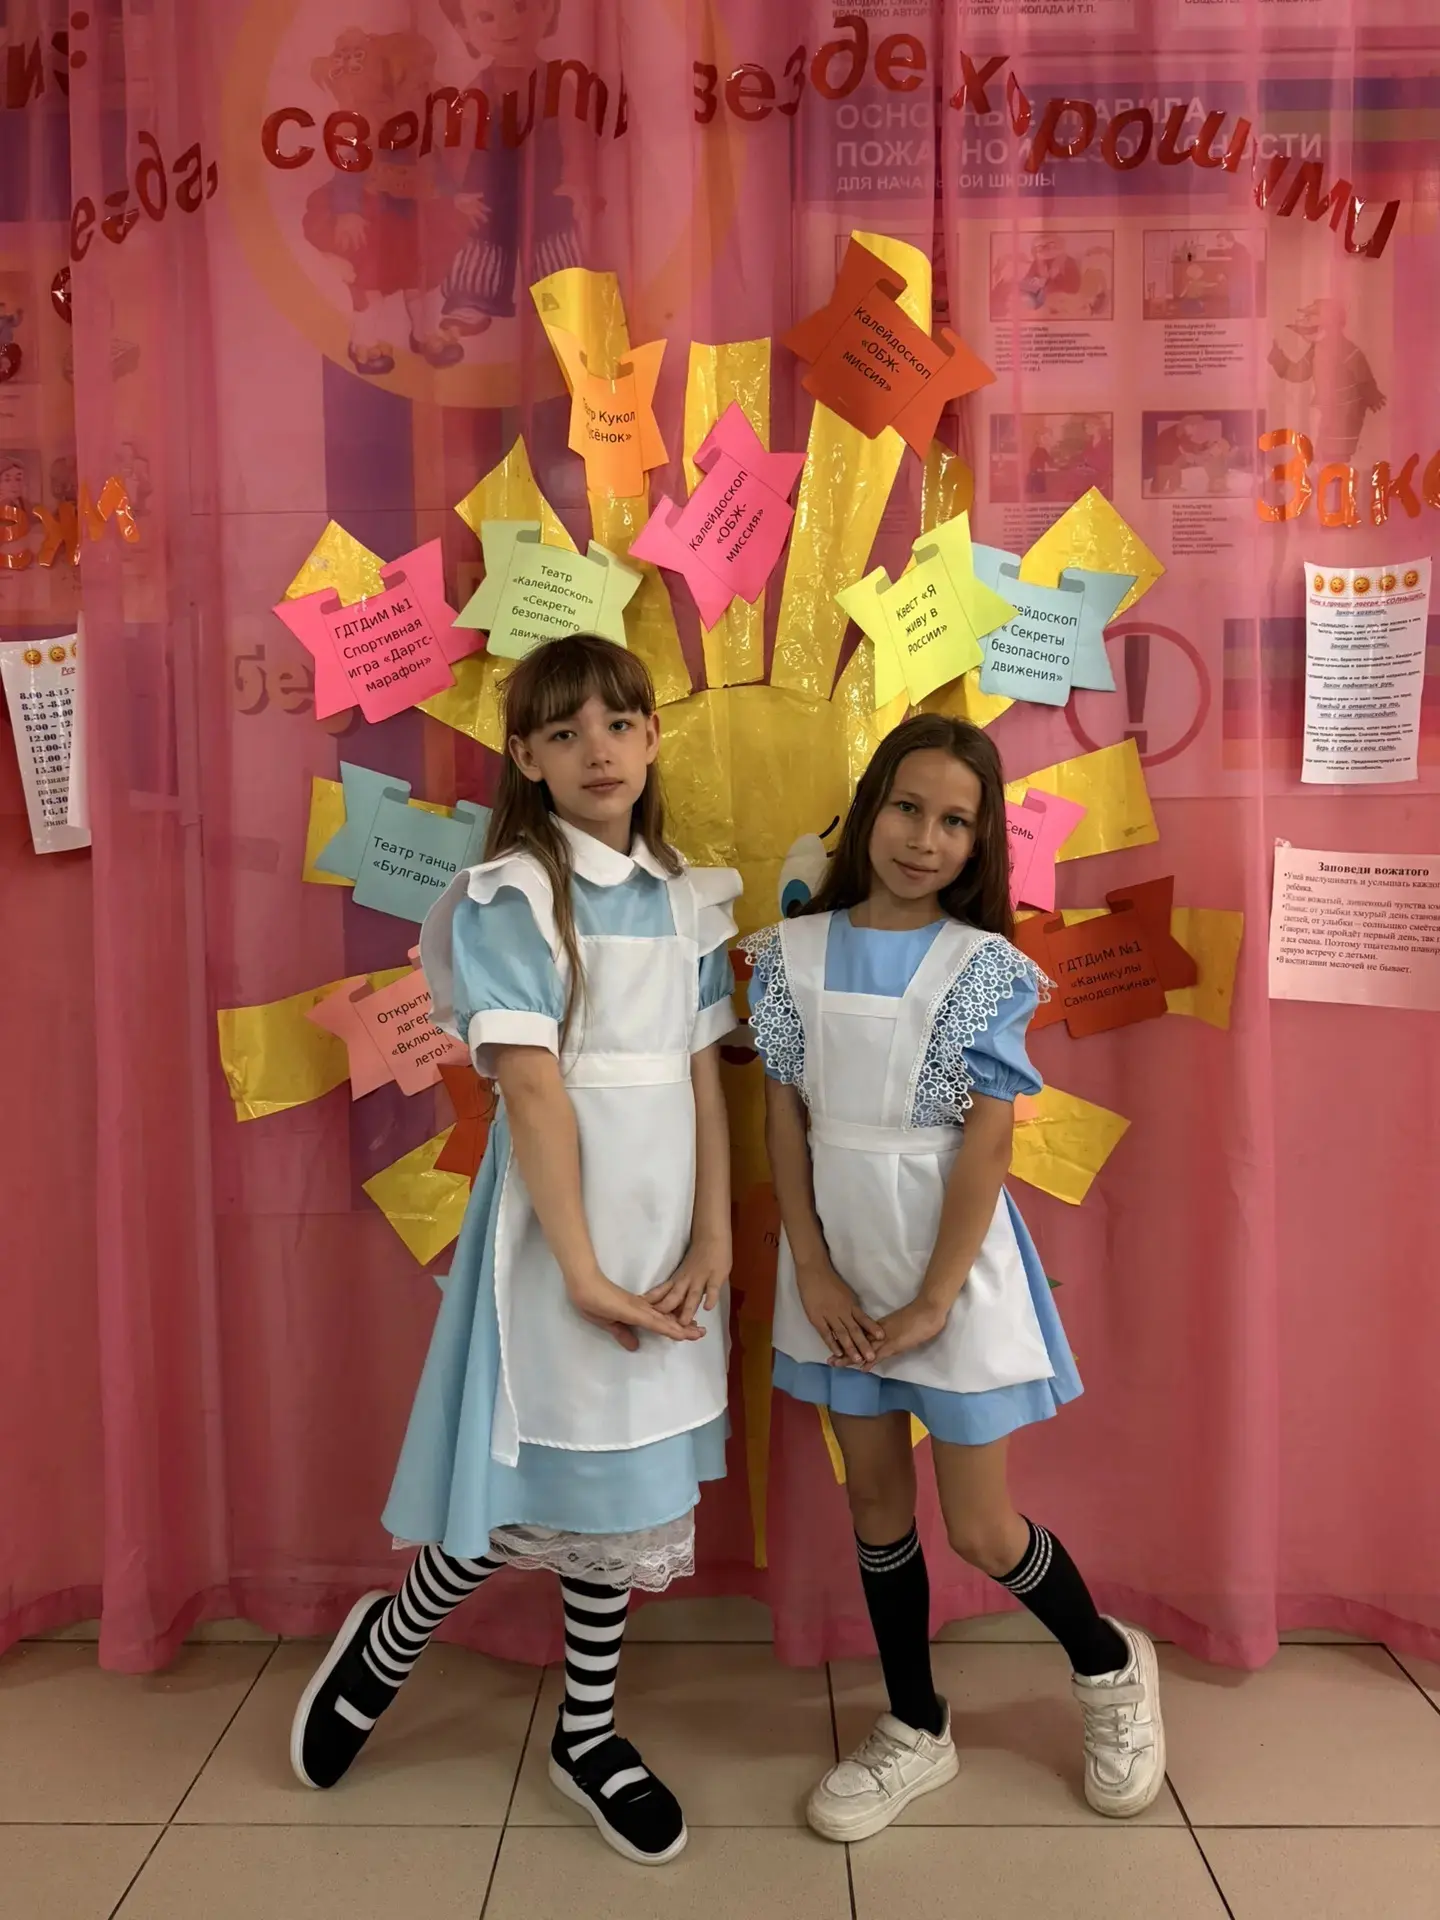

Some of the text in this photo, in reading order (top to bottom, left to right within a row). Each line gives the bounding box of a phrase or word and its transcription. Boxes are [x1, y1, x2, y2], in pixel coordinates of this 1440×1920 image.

[892, 7, 931, 17] АВТОР
[836, 176, 873, 194] ДЛЯ
[853, 306, 932, 380] Калейдоскоп
[861, 339, 900, 374] «ОБЖ-
[842, 351, 892, 392] миссия»
[599, 410, 636, 426] Кукол
[689, 470, 748, 552] Калейдоскоп
[716, 503, 747, 545] «ОБЖ-
[726, 508, 764, 563] миссия»
[541, 565, 573, 583] Театр
[513, 576, 594, 605] «Калейдоскоп»
[896, 584, 937, 621] Квест «Я
[334, 598, 414, 640] ГДТДиМ №1
[511, 605, 581, 632] безопасного
[523, 594, 577, 616] «Секреты
[906, 607, 938, 637] живу в
[343, 618, 423, 659] Спортивная
[991, 638, 1071, 666] безопасного
[348, 635, 434, 680] игра «Дартс-
[991, 660, 1064, 683] движения»
[366, 656, 432, 692] марафон»
[373, 836, 457, 873] Театр танца
[372, 859, 447, 888] «Булгары»
[1318, 861, 1429, 877] Заповеди вожатого
[1320, 907, 1351, 916] улыбки
[1353, 910, 1387, 920] хмурый
[1388, 912, 1409, 920] день
[1321, 918, 1353, 927] улыбки
[1362, 921, 1407, 930] солнышко
[1324, 938, 1361, 950] Поэтому
[1363, 942, 1409, 952] тщательно
[1363, 932, 1396, 941] первый
[1058, 940, 1142, 973] ГДТДиМ №1
[1306, 949, 1337, 959] встречу
[1345, 952, 1379, 960] детьми.
[1329, 961, 1365, 970] мелочей
[1379, 963, 1412, 974] бывает.
[1070, 962, 1142, 989] «Каникулы
[1064, 976, 1157, 1008] Самоделкина»
[377, 992, 432, 1025] Открыти
[396, 1012, 430, 1036] лагер
[414, 1042, 454, 1068] лето!»
